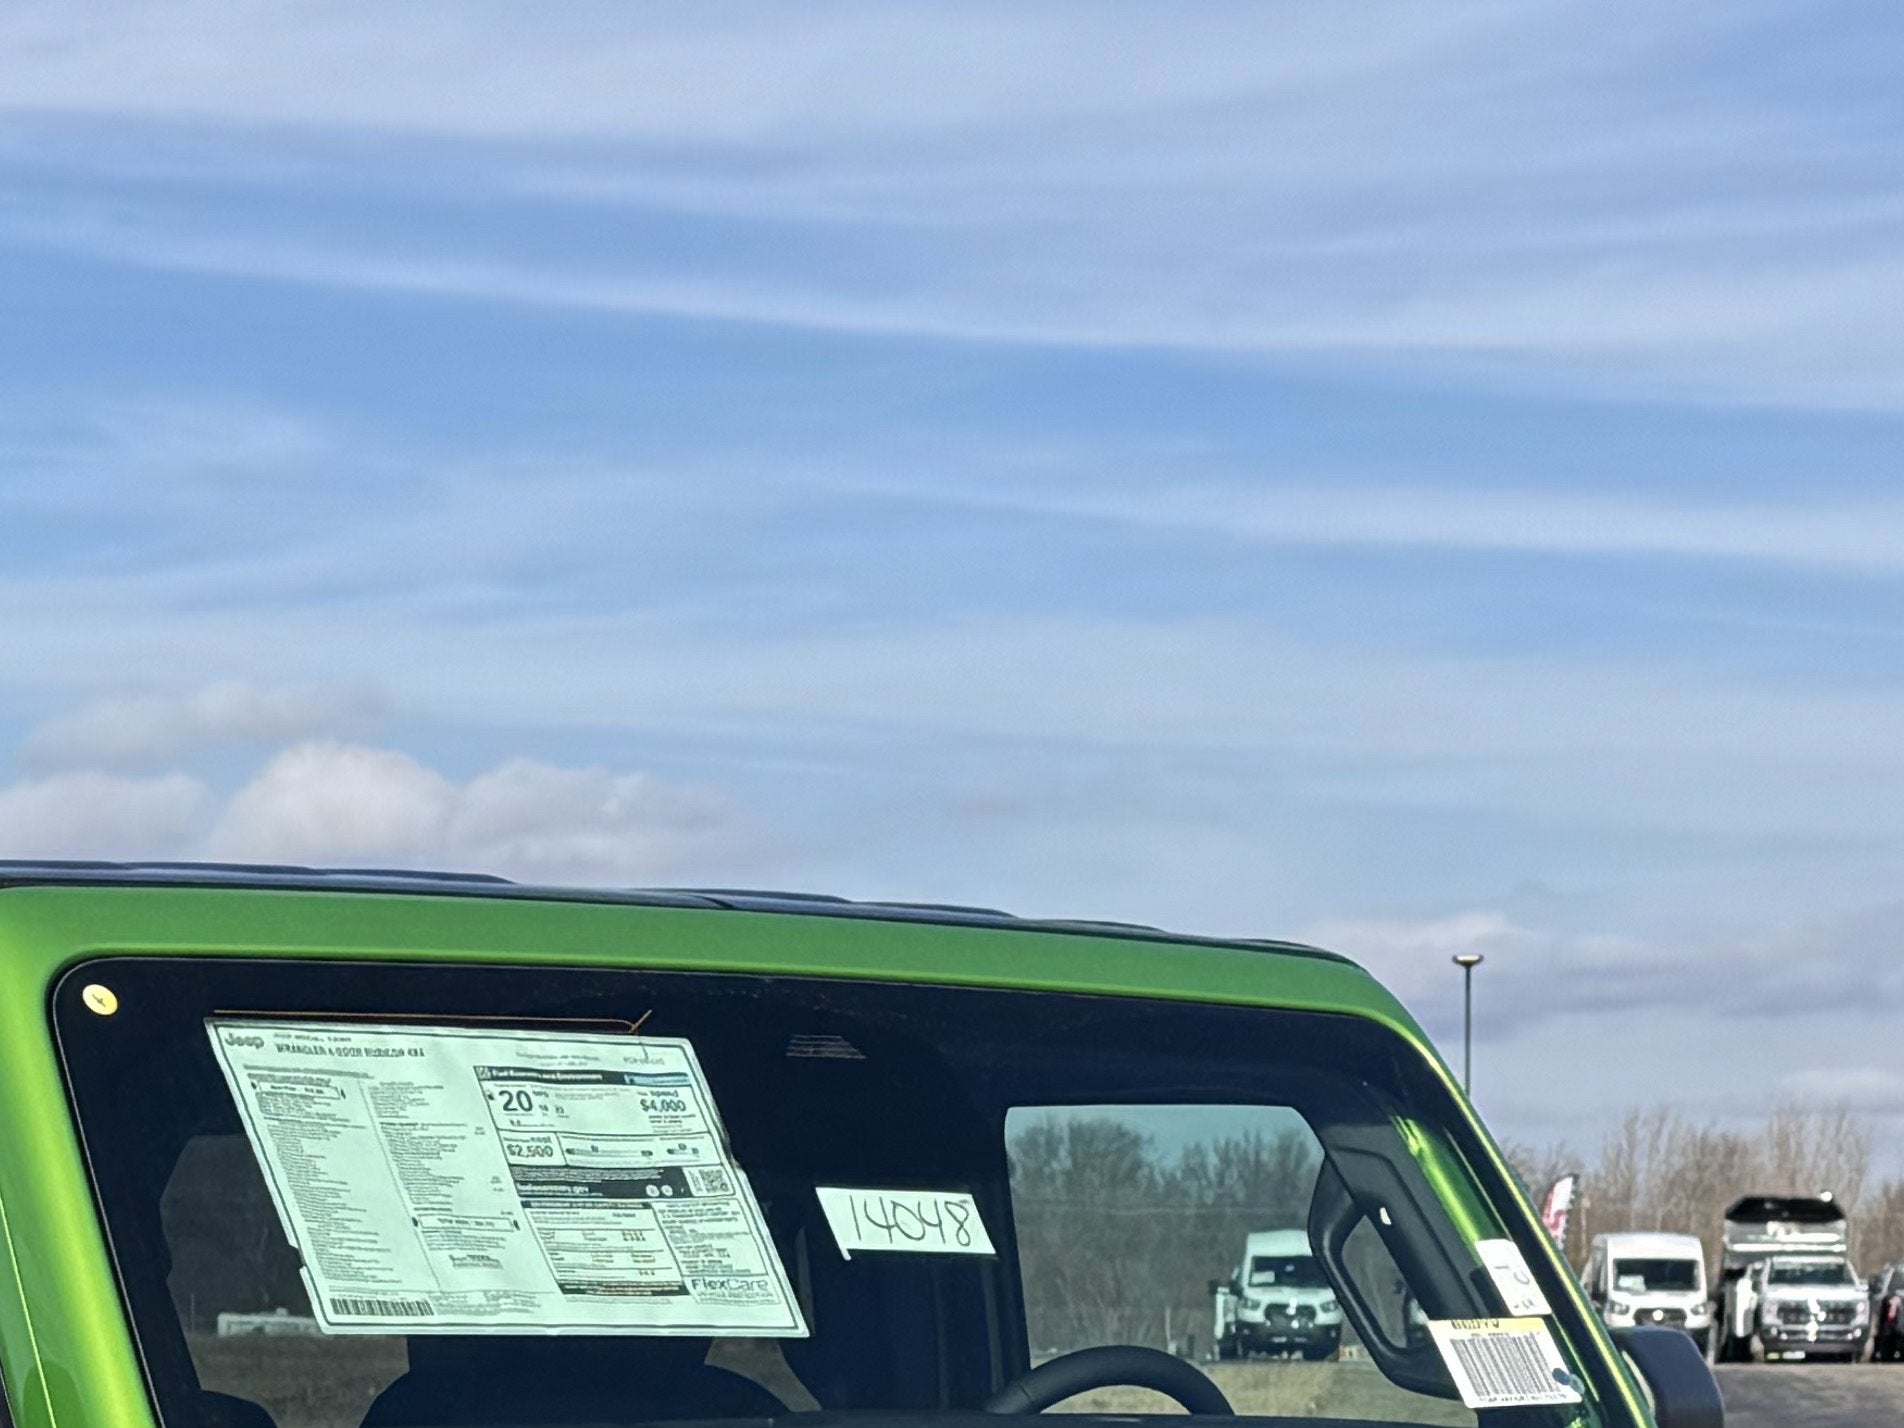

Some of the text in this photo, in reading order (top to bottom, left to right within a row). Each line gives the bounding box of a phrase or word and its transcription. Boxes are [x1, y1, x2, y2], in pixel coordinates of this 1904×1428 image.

[224, 1032, 265, 1049] Jeep
[498, 1089, 533, 1112] 20
[639, 1098, 687, 1113] $4,000
[849, 1194, 971, 1247] 14048
[691, 1278, 769, 1291] FlexCare
